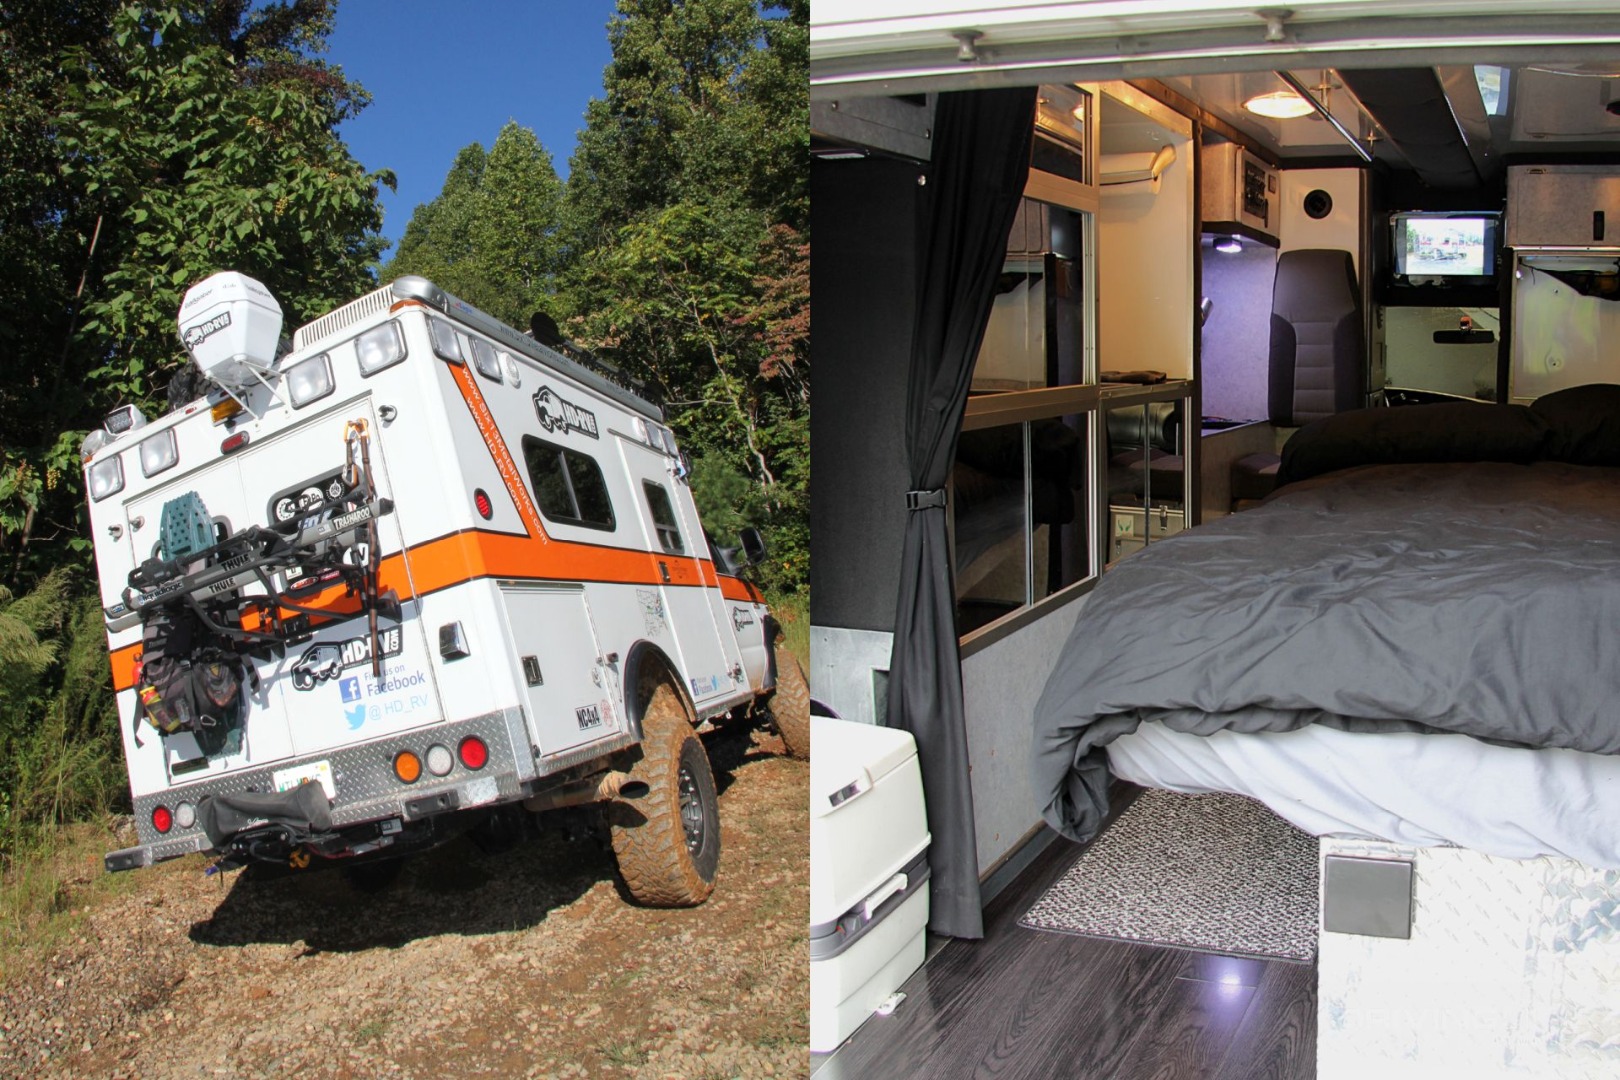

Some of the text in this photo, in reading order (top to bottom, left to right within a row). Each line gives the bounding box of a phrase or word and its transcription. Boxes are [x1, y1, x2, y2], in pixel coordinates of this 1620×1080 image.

[462, 367, 548, 545] www.Six13MetalWorks.com
[333, 507, 370, 531] TRASHAROO
[221, 553, 250, 572] THULE
[208, 577, 236, 594] THULE
[394, 664, 405, 673] on
[367, 670, 426, 697] Facebook
[384, 694, 428, 715] HD_RV
[576, 706, 600, 729] NC4x4
